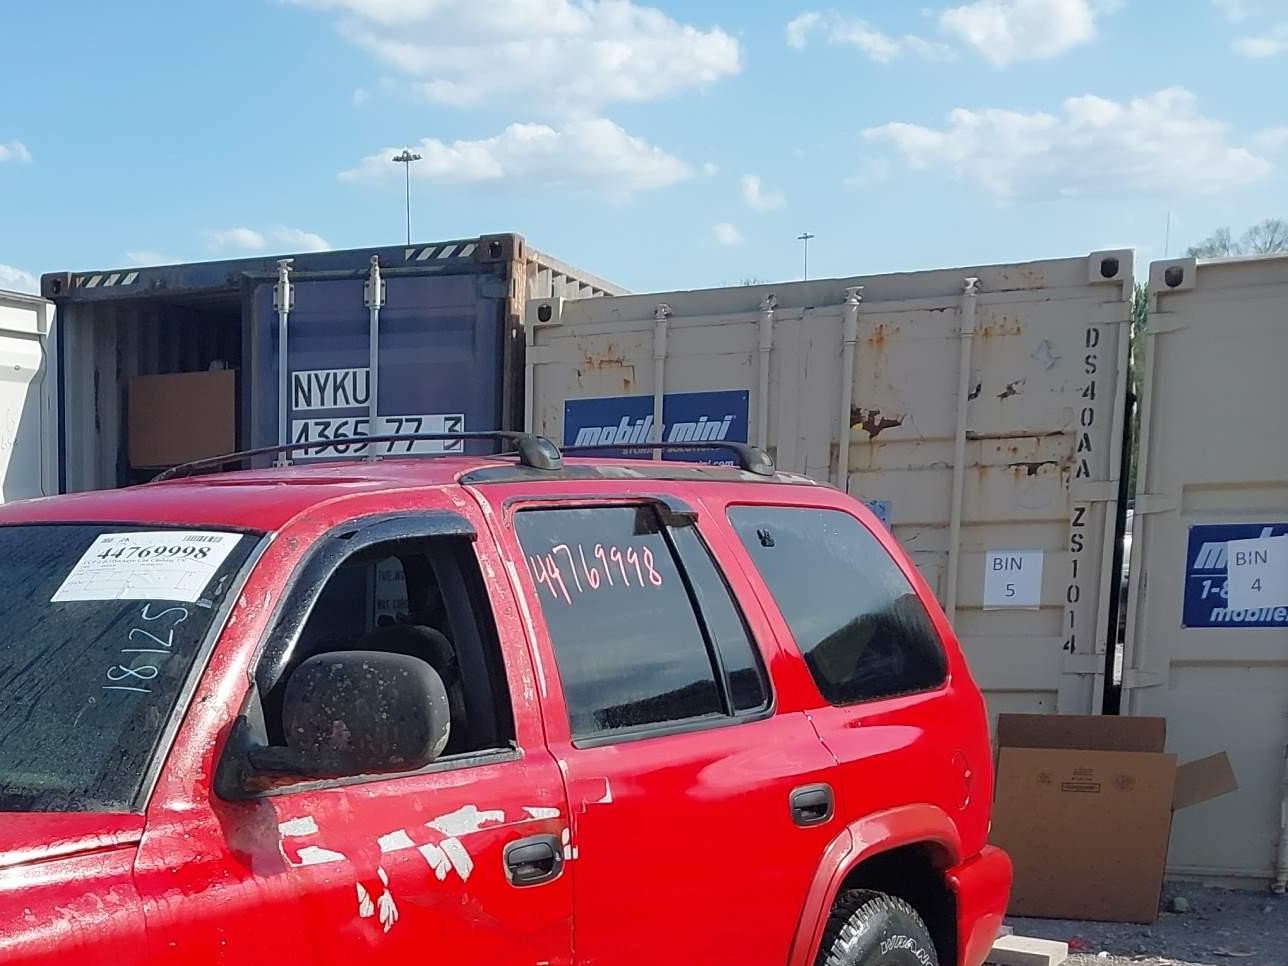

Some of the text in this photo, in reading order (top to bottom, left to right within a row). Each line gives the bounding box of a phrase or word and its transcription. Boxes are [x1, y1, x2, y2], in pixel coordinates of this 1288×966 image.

[294, 370, 370, 408] NYKU
[668, 415, 733, 442] mini
[1063, 327, 1100, 654] DS40AA ZS1014
[97, 545, 211, 560] 44769998
[1236, 550, 1267, 566] BIN
[993, 557, 1022, 571] BIN
[530, 543, 662, 605] 44769998
[1006, 583, 1015, 597] 5
[1251, 578, 1262, 592] 4
